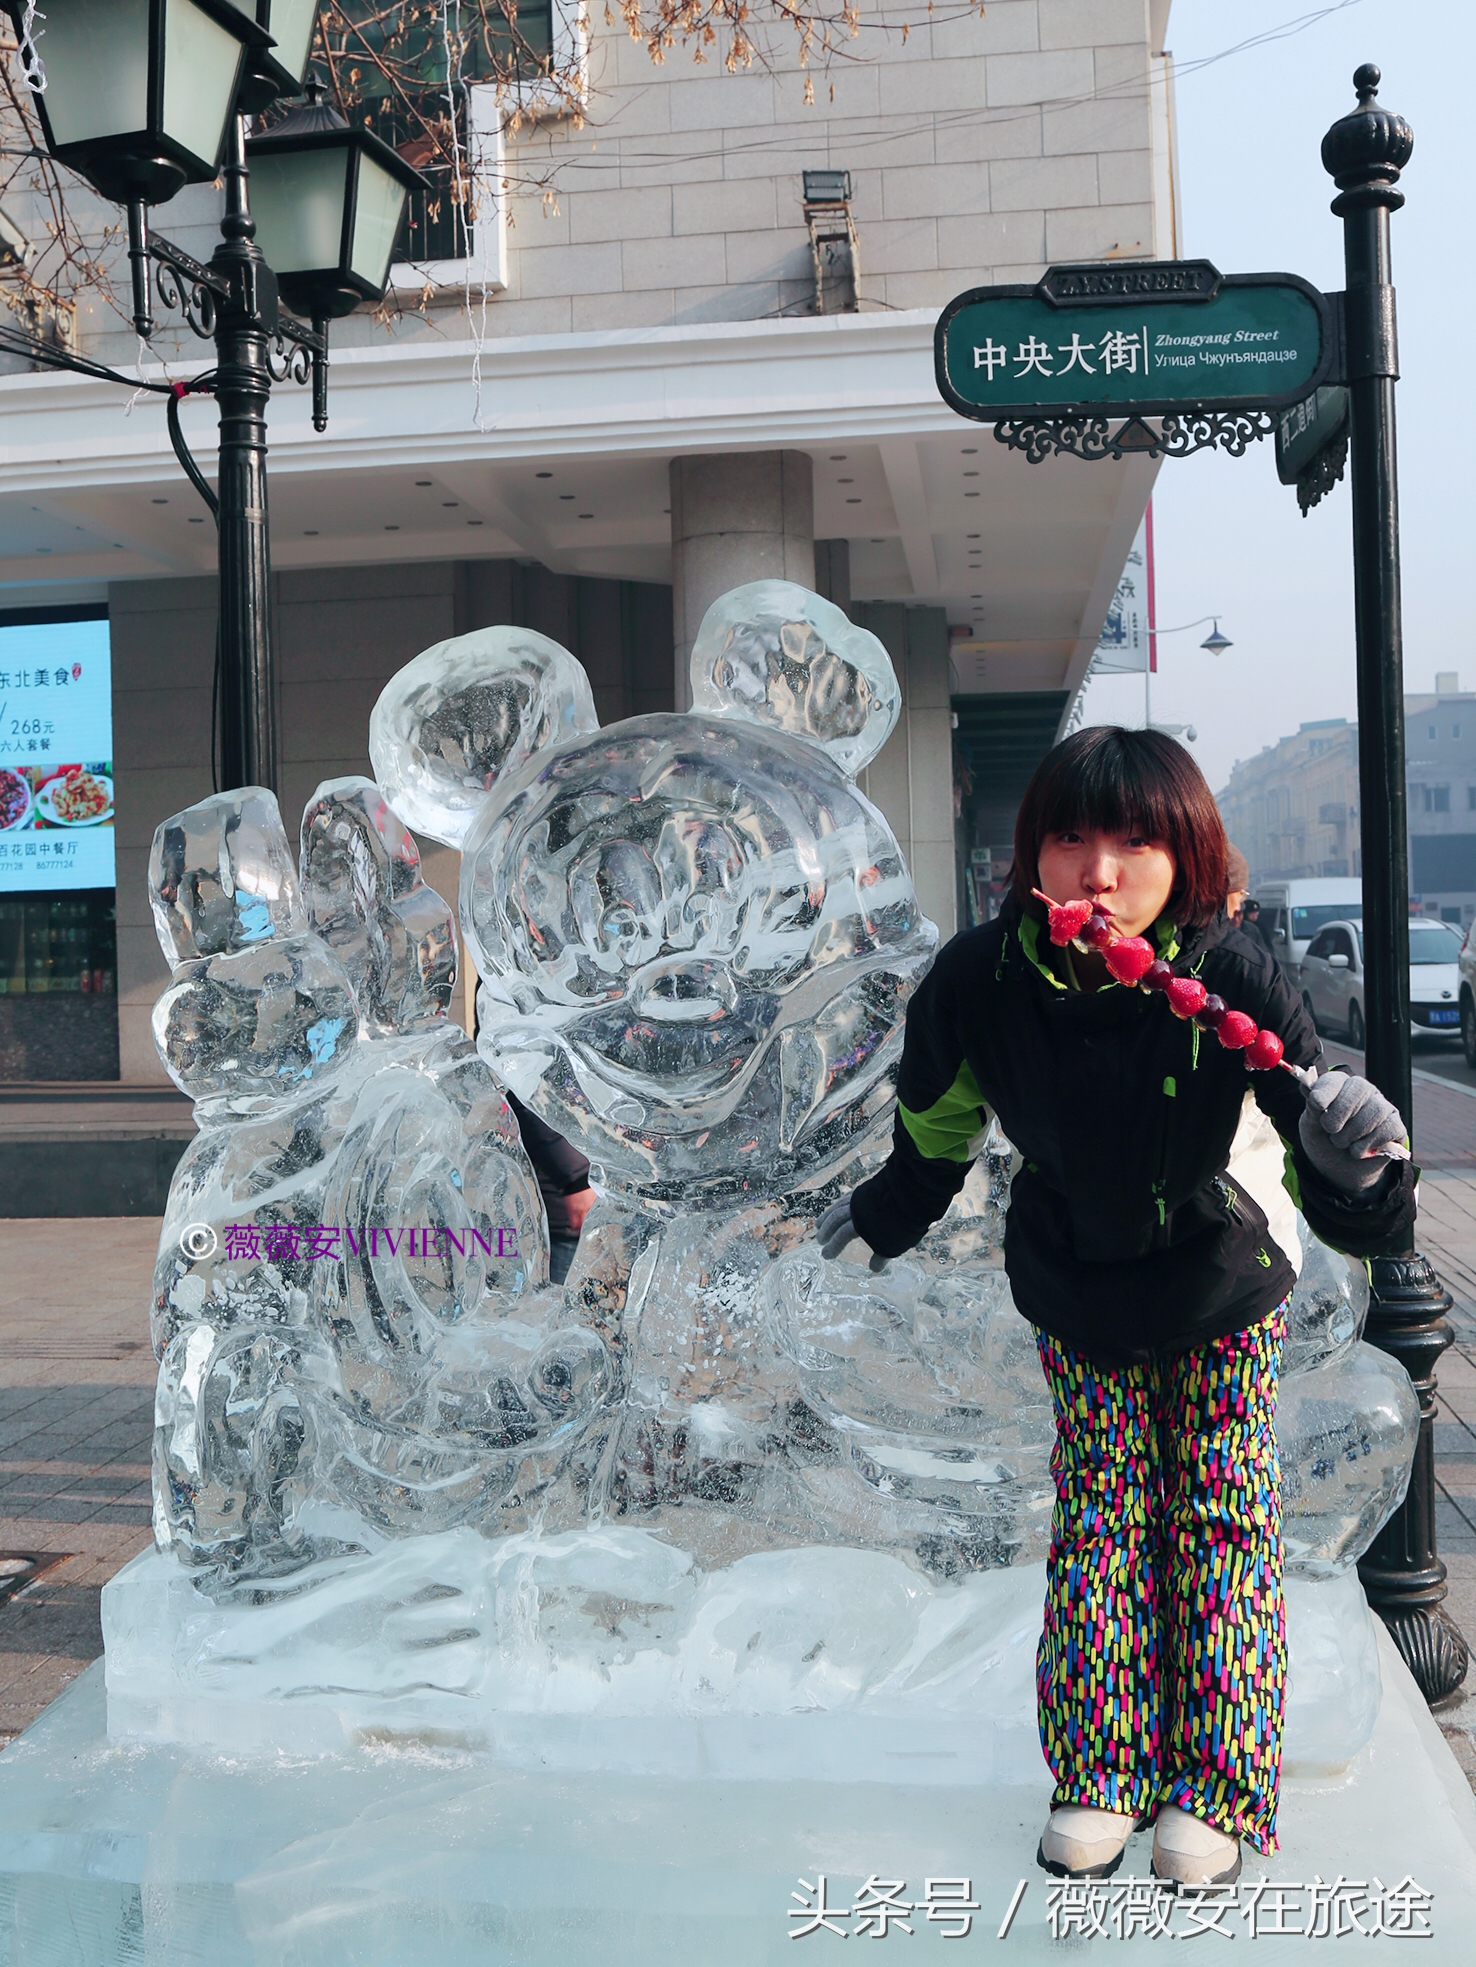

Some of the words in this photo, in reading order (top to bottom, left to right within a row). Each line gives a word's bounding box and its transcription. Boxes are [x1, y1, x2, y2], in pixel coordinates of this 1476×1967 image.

[1154, 333, 1232, 347] Zhongyang
[1234, 330, 1280, 342] Street
[973, 330, 1142, 381] 中央大街
[1154, 353, 1196, 368] Улица
[1199, 349, 1298, 367] Чжунъяндацзе
[0, 667, 70, 690] 东北美食
[11, 718, 55, 735] 268元
[0, 737, 51, 753] 六人套餐
[0, 841, 78, 857] 百花园中餐厅
